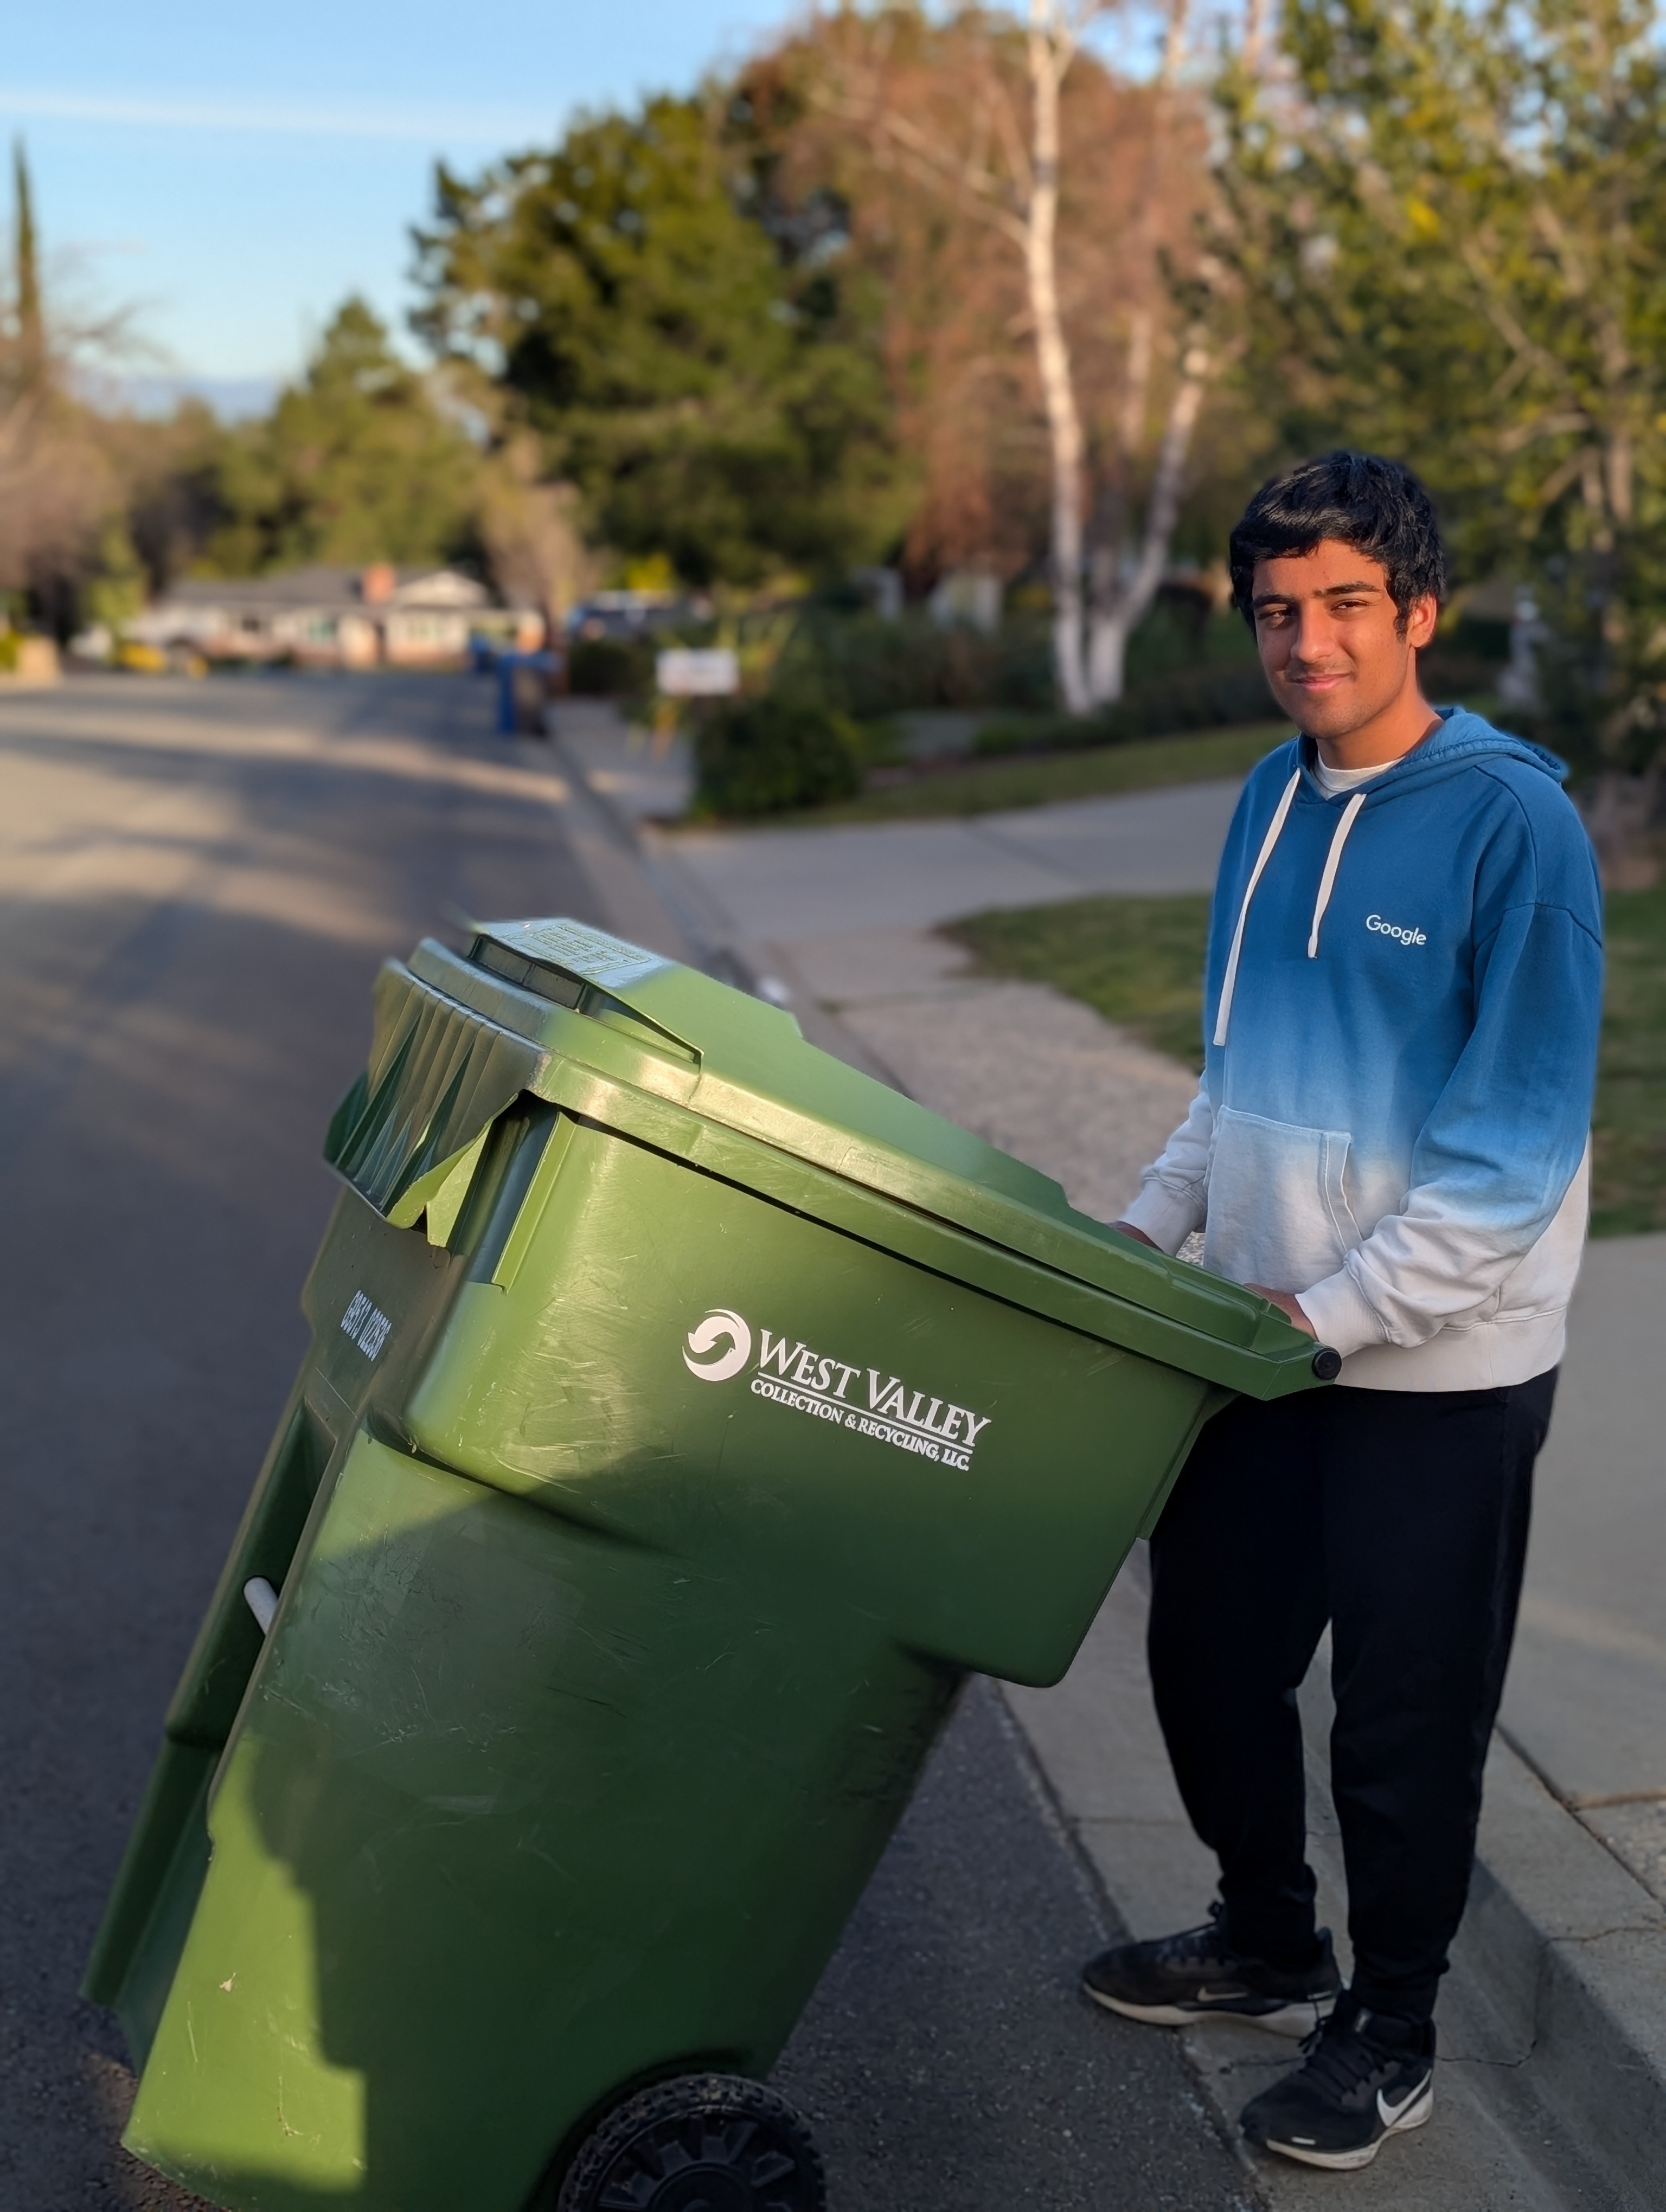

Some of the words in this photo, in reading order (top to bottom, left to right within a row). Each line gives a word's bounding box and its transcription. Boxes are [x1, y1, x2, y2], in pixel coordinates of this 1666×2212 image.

[1366, 914, 1427, 946] Google
[751, 1379, 845, 1424] COLLECTION
[844, 1413, 856, 1430] &
[857, 1417, 940, 1462] RECYCLING,
[759, 1328, 861, 1399] WEST
[867, 1368, 992, 1447] VALLEY
